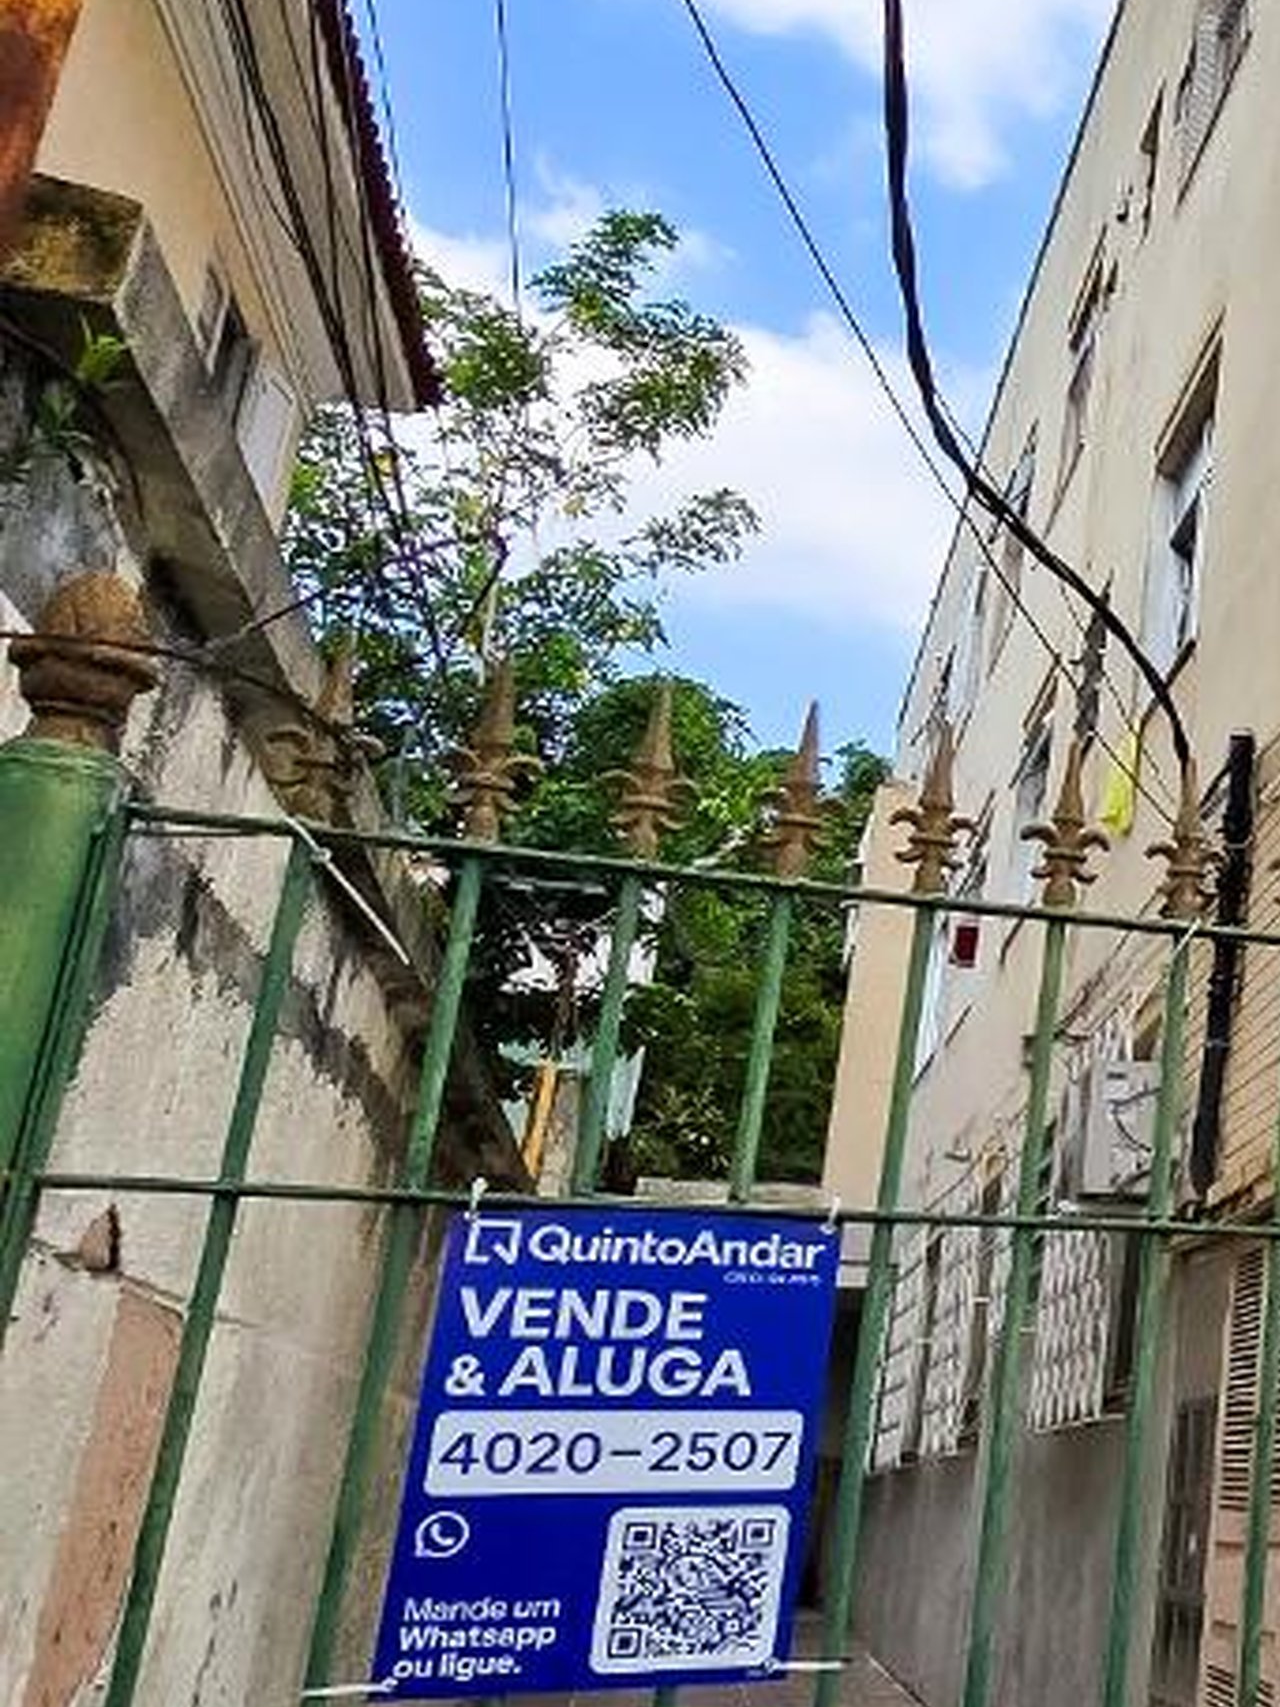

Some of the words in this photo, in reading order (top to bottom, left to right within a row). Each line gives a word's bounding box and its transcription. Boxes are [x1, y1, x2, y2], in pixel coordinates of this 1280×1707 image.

[528, 1224, 826, 1269] QuintoAndar
[459, 1287, 707, 1341] VENDE
[444, 1354, 486, 1397] &
[500, 1345, 752, 1397] ALUGA
[438, 1431, 793, 1476] 4020-2507
[402, 1596, 508, 1622] Mande
[512, 1597, 561, 1619] um
[400, 1624, 557, 1652] Whatsapp
[392, 1659, 433, 1679] ou
[438, 1651, 522, 1682] ligue.
